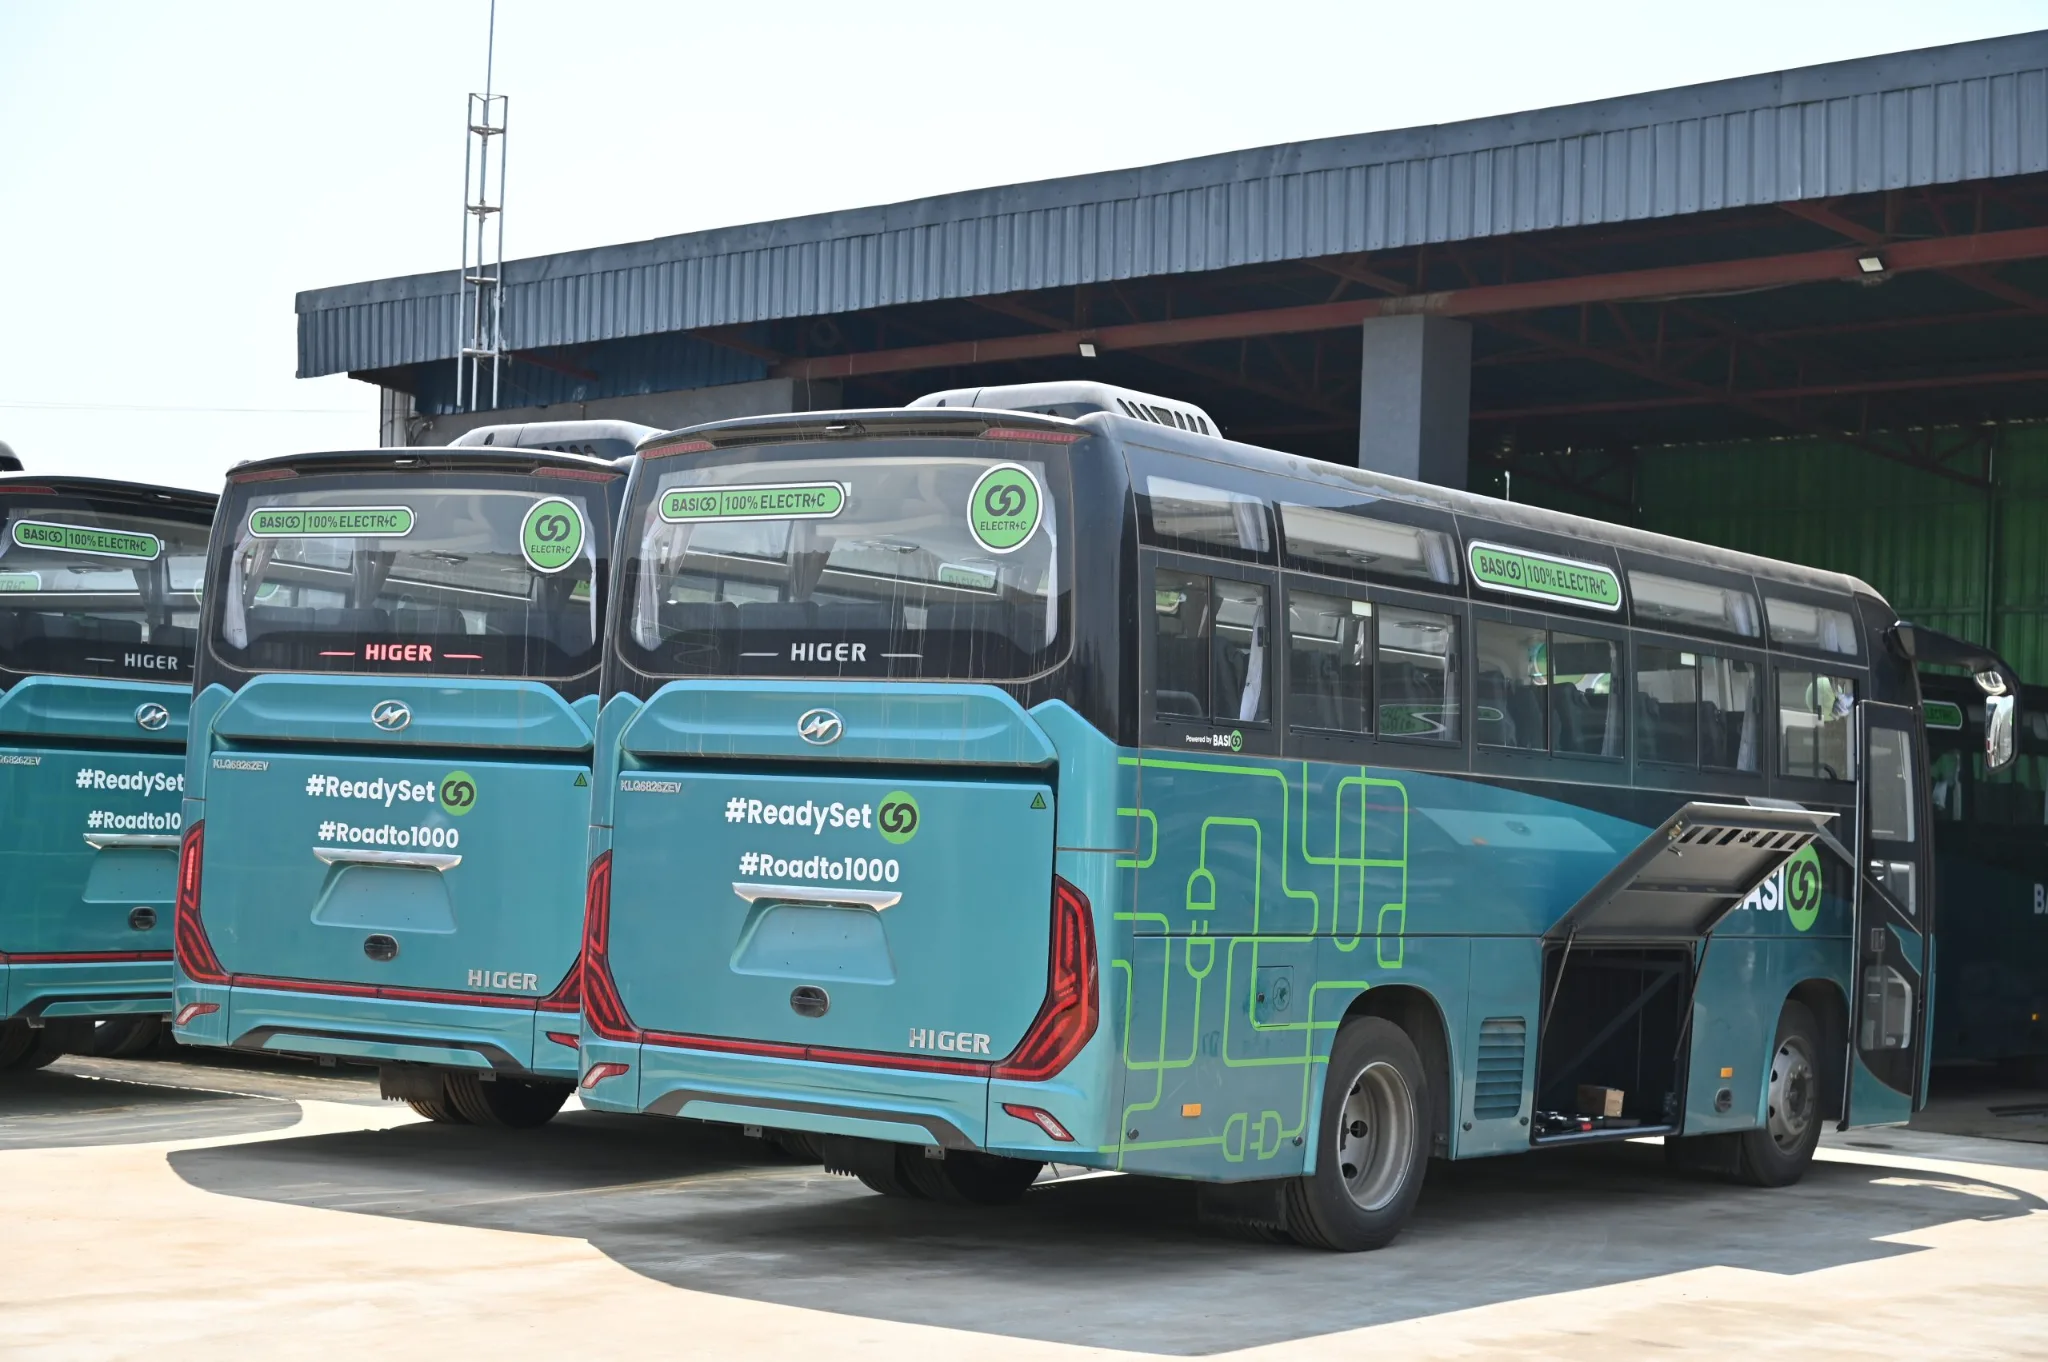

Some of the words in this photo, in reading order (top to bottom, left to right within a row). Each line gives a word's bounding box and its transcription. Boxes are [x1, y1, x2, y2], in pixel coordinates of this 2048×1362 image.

[671, 496, 717, 512] BASIGO
[725, 495, 758, 510] 100%
[760, 492, 826, 509] ELECTRIC
[259, 515, 301, 529] BASIGO
[307, 514, 338, 528] 100%
[339, 514, 398, 528] ELECTRIC
[980, 520, 1027, 532] ELECTRIC
[69, 533, 97, 547] 100%
[97, 536, 147, 552] ELECTRIC
[530, 544, 571, 554] ELECTRIC
[1479, 555, 1522, 581] BASIGO
[1527, 564, 1557, 587] 100%
[1557, 570, 1608, 597] ELECTRIC
[124, 653, 178, 670] HIGER
[365, 643, 432, 662] HIGER
[790, 642, 867, 663] HIGER
[1185, 734, 1206, 743] Powered
[1206, 736, 1212, 745] by
[75, 768, 184, 797] #ReadySet
[305, 773, 436, 808] #ReadySet
[87, 809, 182, 830] #Roadto10
[724, 796, 872, 835] #ReadySet
[317, 820, 460, 849] #Roadto1000
[738, 851, 900, 883] #Roadto1000
[467, 968, 538, 991] HIGER
[908, 1027, 991, 1055] HIGER
